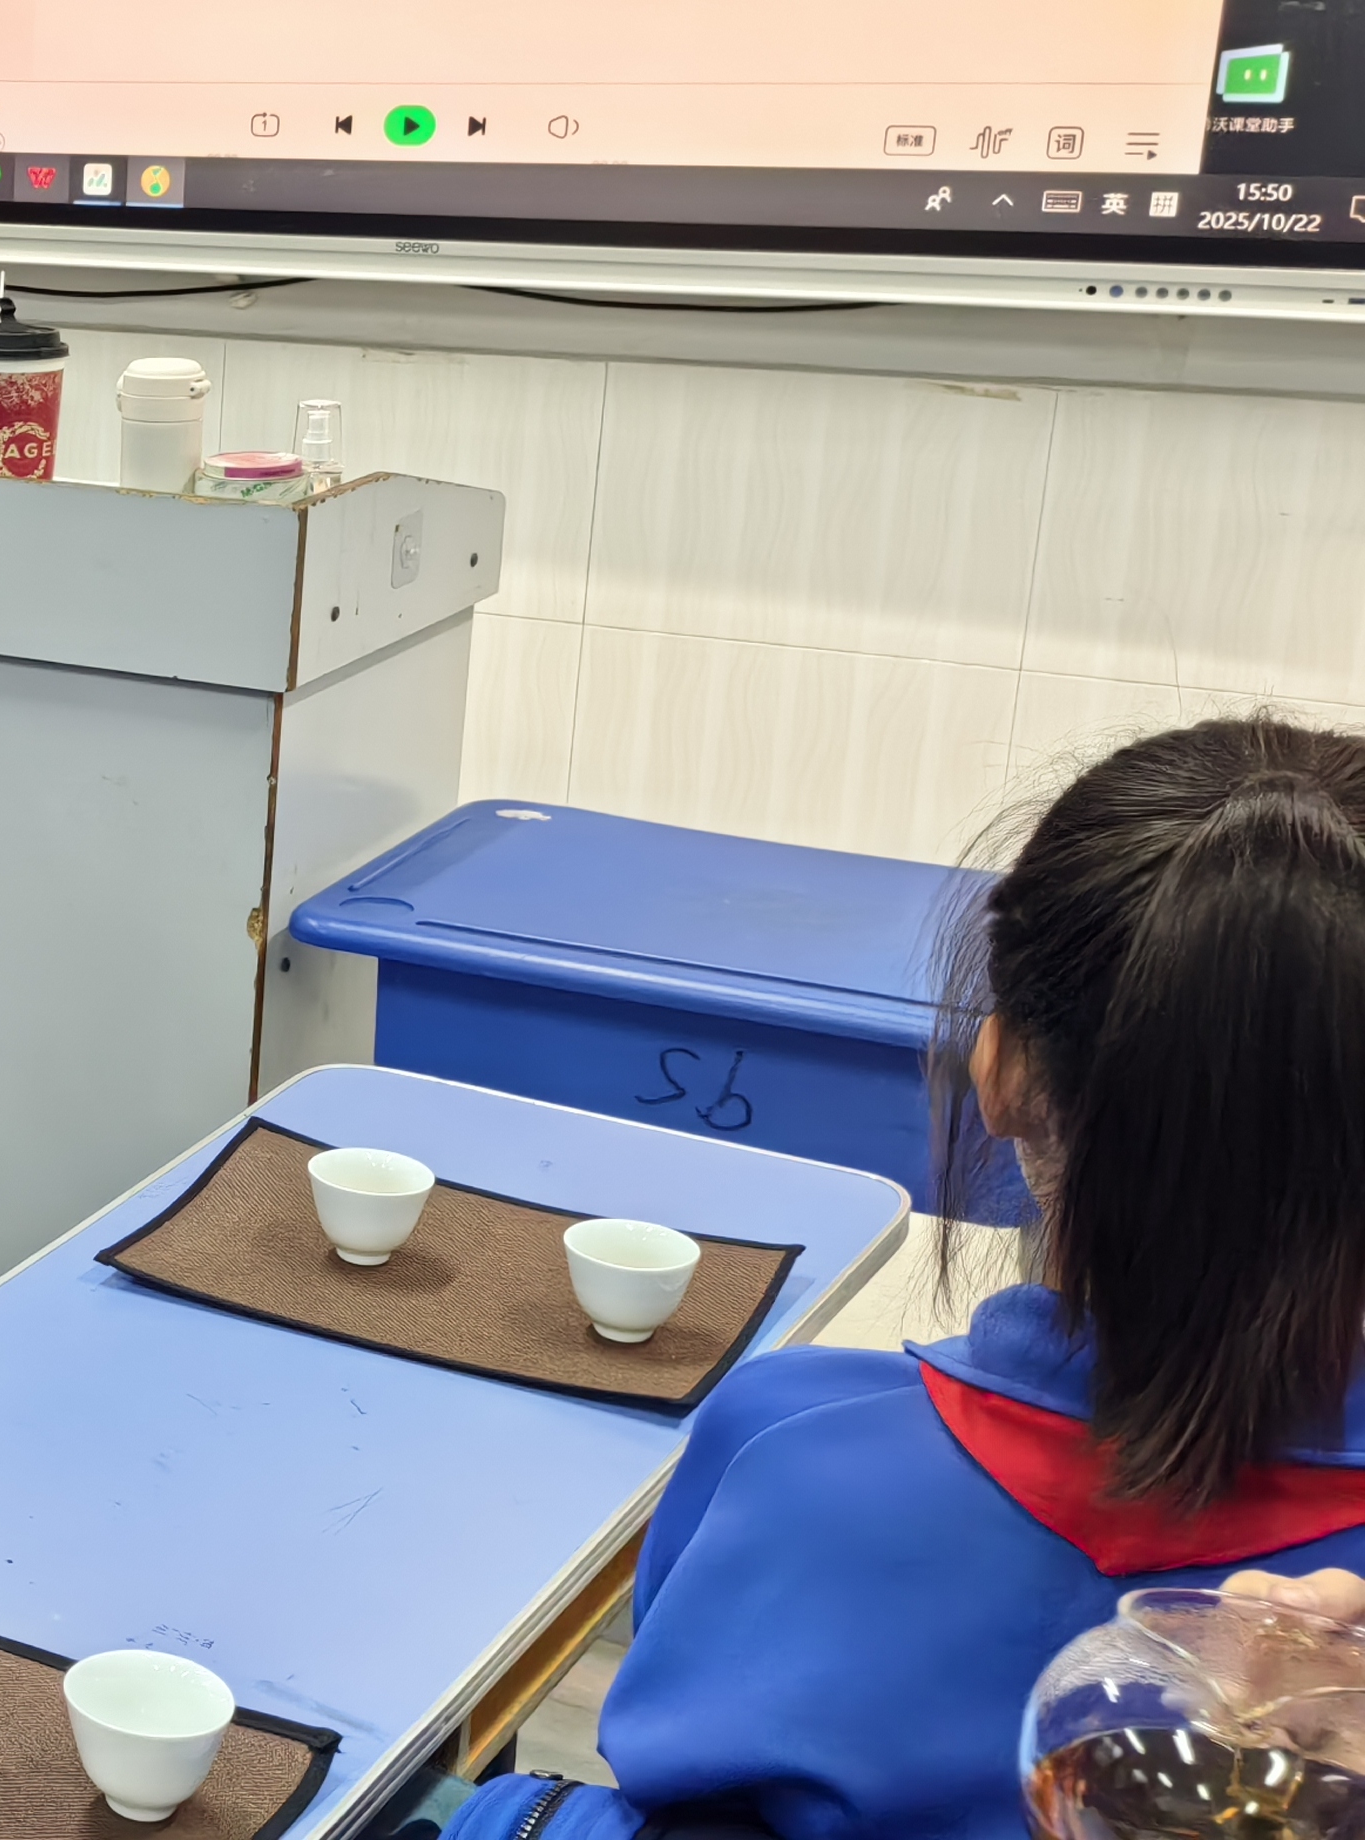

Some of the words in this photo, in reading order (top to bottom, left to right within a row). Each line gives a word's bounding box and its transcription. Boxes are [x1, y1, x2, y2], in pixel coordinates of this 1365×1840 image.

[895, 133, 925, 148] 标准
[1053, 133, 1077, 155] 词
[1235, 182, 1293, 202] 15:50
[1100, 191, 1129, 216] 英
[1152, 193, 1176, 216] 拼
[1196, 210, 1323, 233] 2025/10/22
[394, 241, 440, 254] seewo
